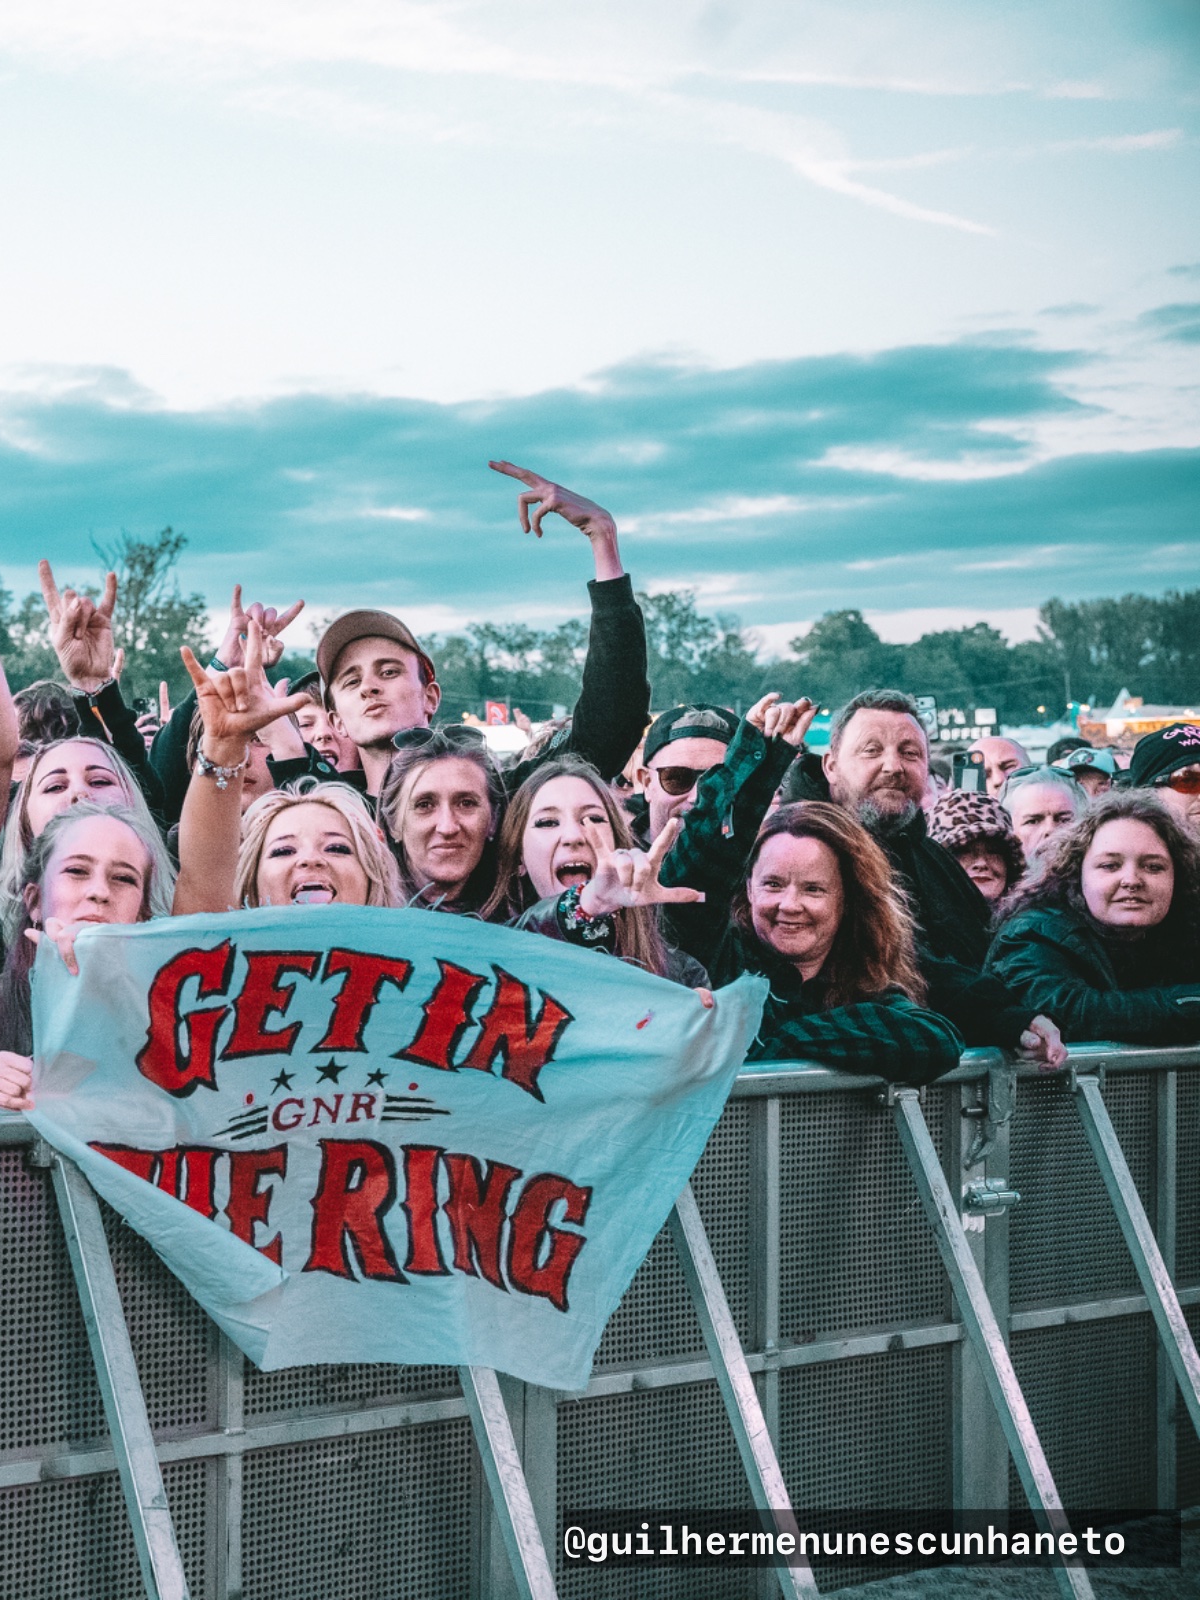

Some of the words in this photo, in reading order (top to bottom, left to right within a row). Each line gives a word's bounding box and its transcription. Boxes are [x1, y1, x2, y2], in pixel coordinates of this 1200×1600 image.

[135, 939, 414, 1099] GET
[394, 956, 574, 1104] IN
[270, 1092, 378, 1133] GNR
[301, 1138, 593, 1312] RING
